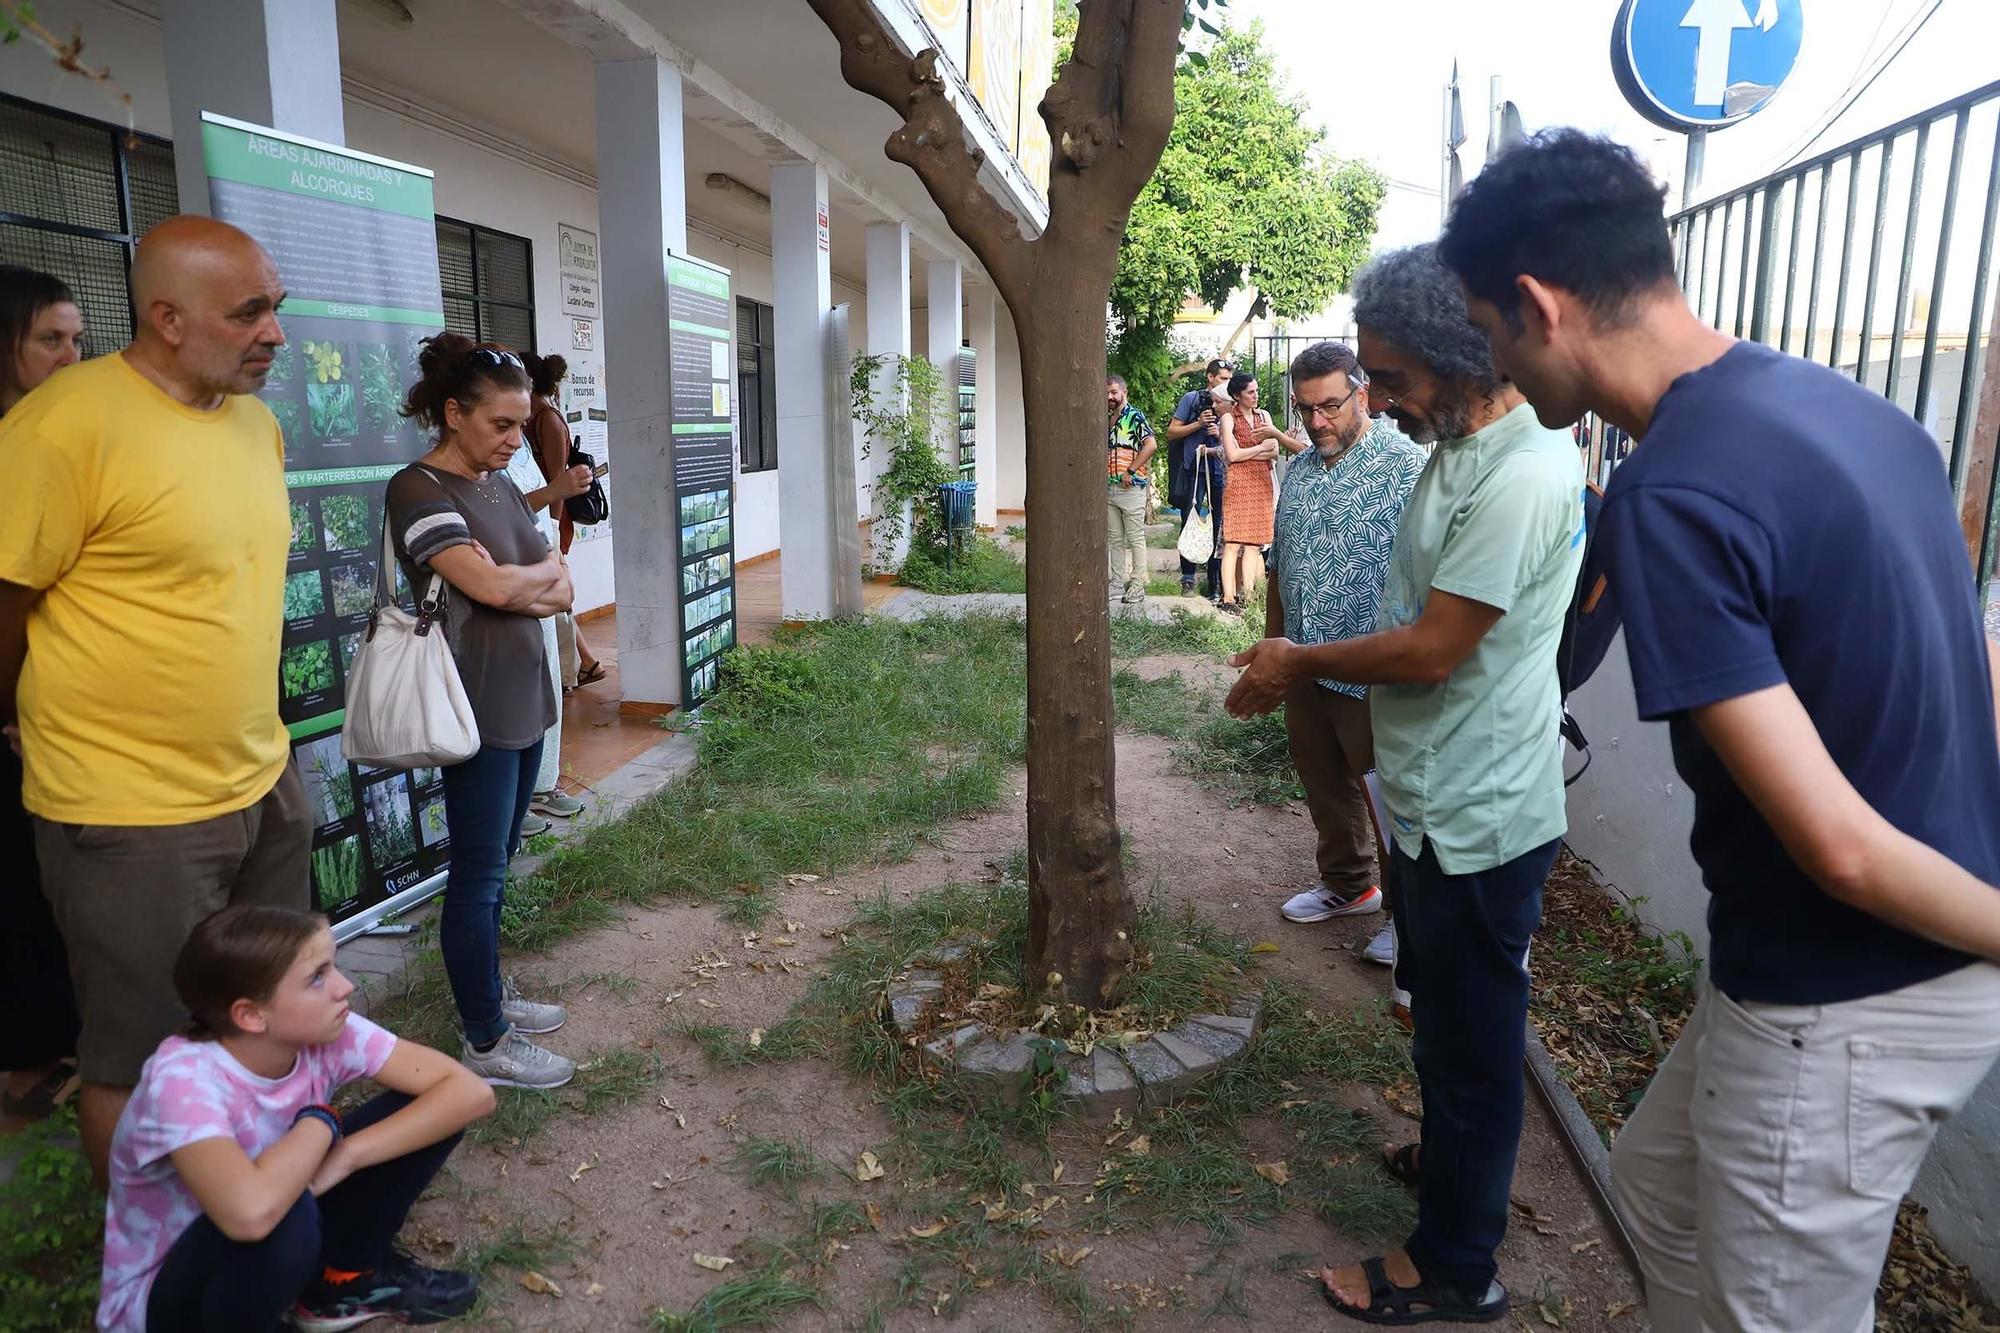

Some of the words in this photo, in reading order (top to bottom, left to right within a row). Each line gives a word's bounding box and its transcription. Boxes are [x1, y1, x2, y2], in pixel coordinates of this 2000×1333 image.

[302, 151, 392, 185] AJARDINADAS
[392, 172, 403, 186] Y
[290, 170, 375, 202] ALCORQUES
[572, 374, 588, 385] Banco
[588, 374, 595, 385] de
[573, 387, 595, 397] recursos
[306, 470, 356, 483] PARTERRES
[356, 469, 374, 480] CON
[396, 869, 420, 888] SCHN
